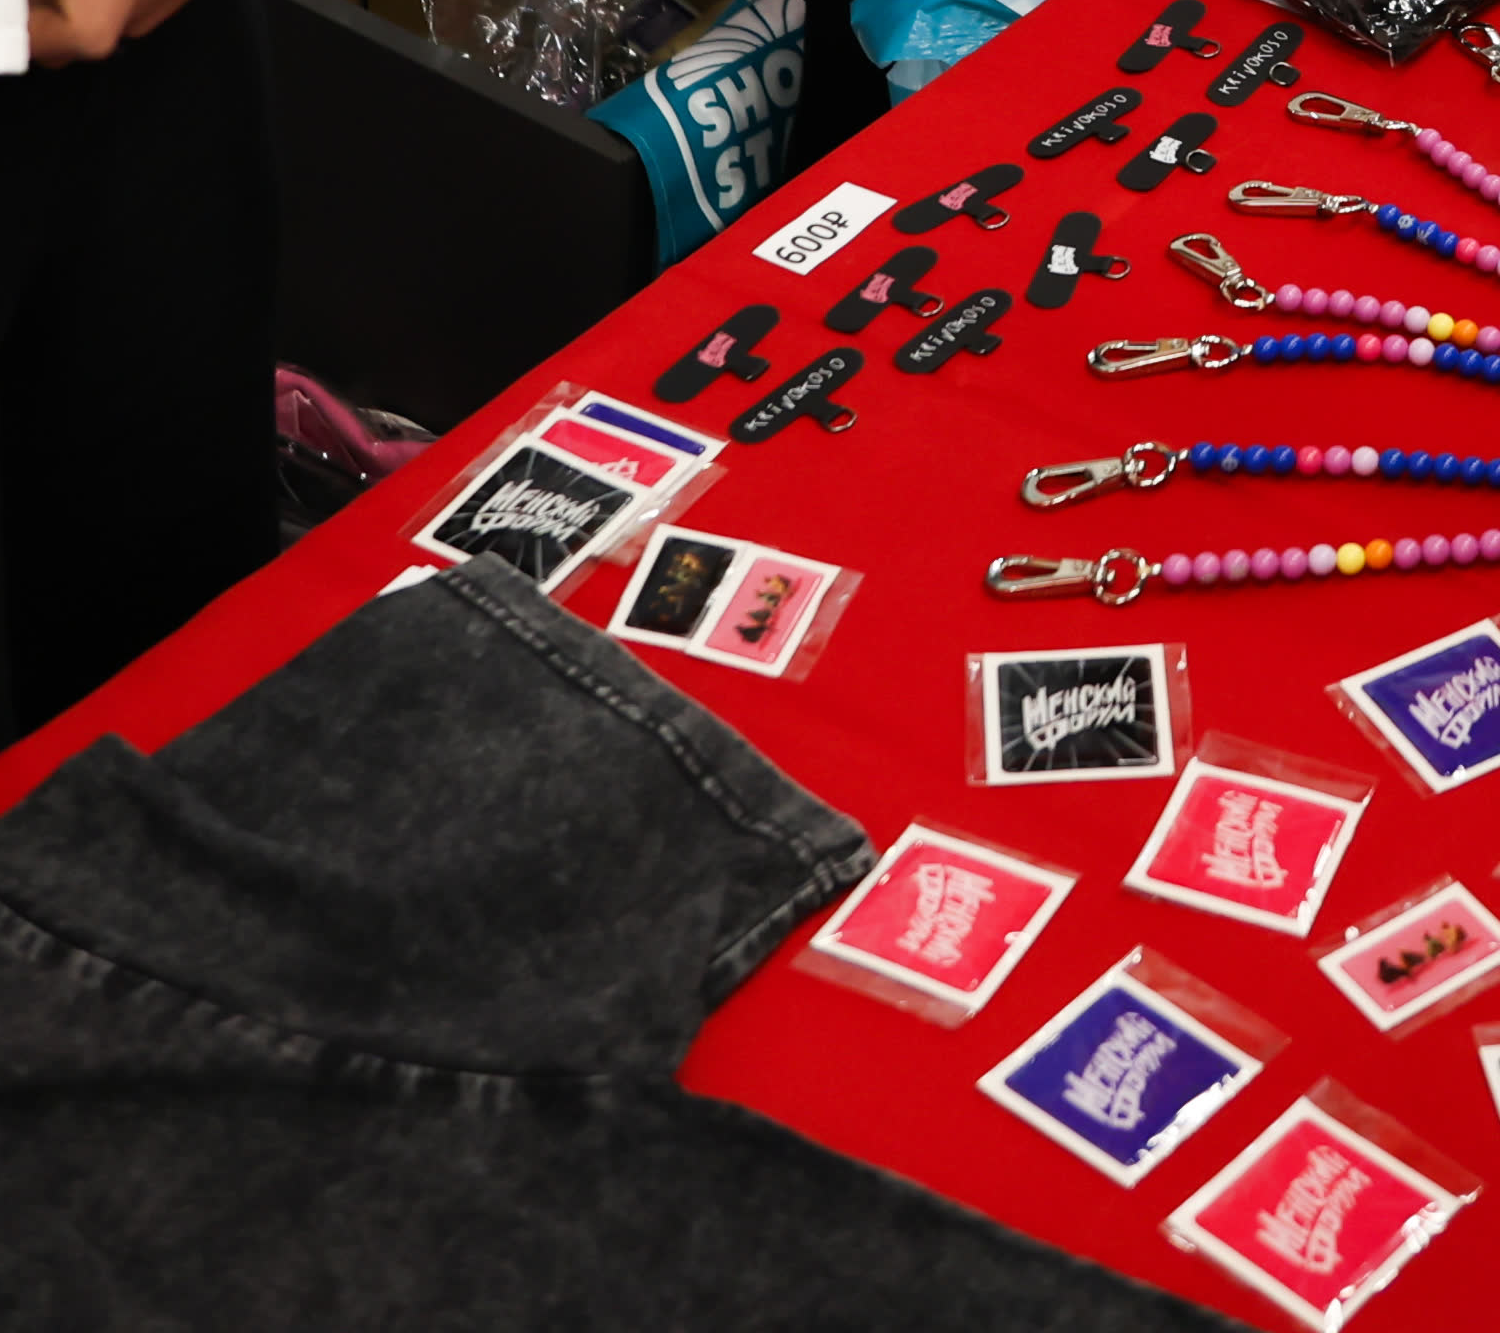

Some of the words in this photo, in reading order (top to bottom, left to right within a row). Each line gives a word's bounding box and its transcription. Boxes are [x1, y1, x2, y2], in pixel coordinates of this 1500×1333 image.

[688, 38, 804, 149] SHO
[715, 116, 793, 209] ST
[775, 211, 849, 264] 600₽
